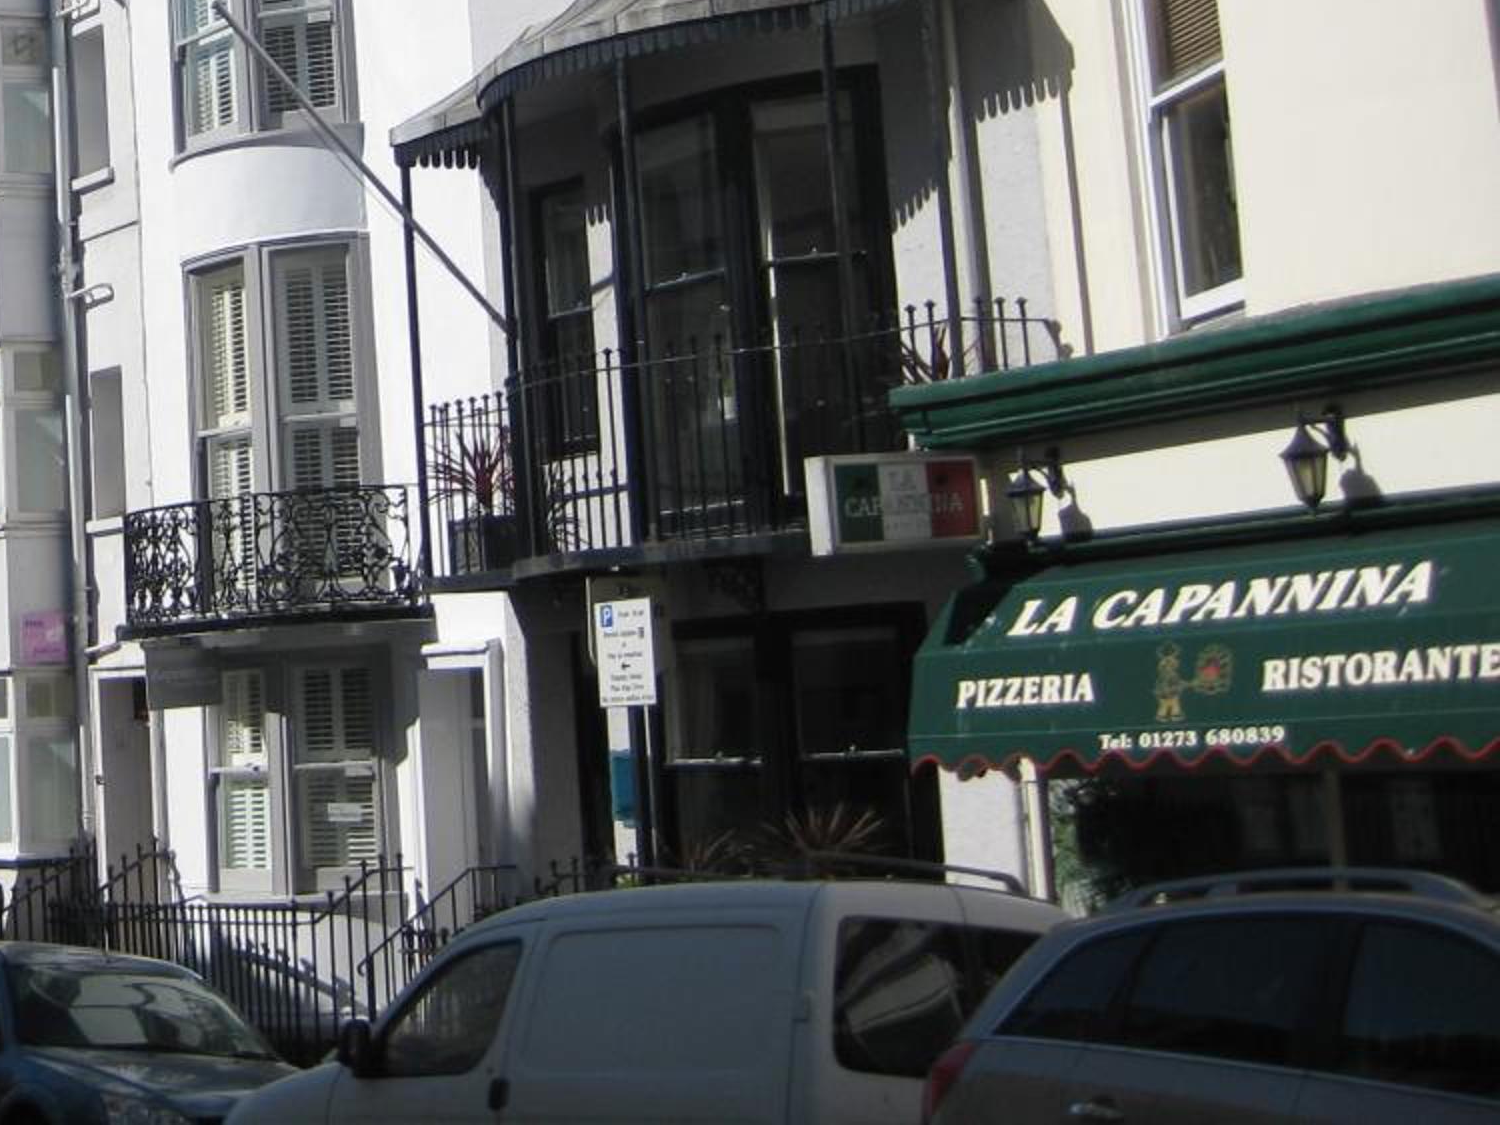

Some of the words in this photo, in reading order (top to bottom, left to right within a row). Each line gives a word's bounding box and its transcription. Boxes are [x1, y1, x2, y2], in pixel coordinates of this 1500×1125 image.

[1006, 596, 1078, 636] LA
[1092, 560, 1432, 629] CAPANNINA
[1262, 642, 1500, 691] RISTORANTE
[956, 673, 1094, 709] PIZZERIA
[1099, 733, 1132, 750] Tel:
[1139, 730, 1197, 748] 01273
[1205, 726, 1285, 745] 680839
